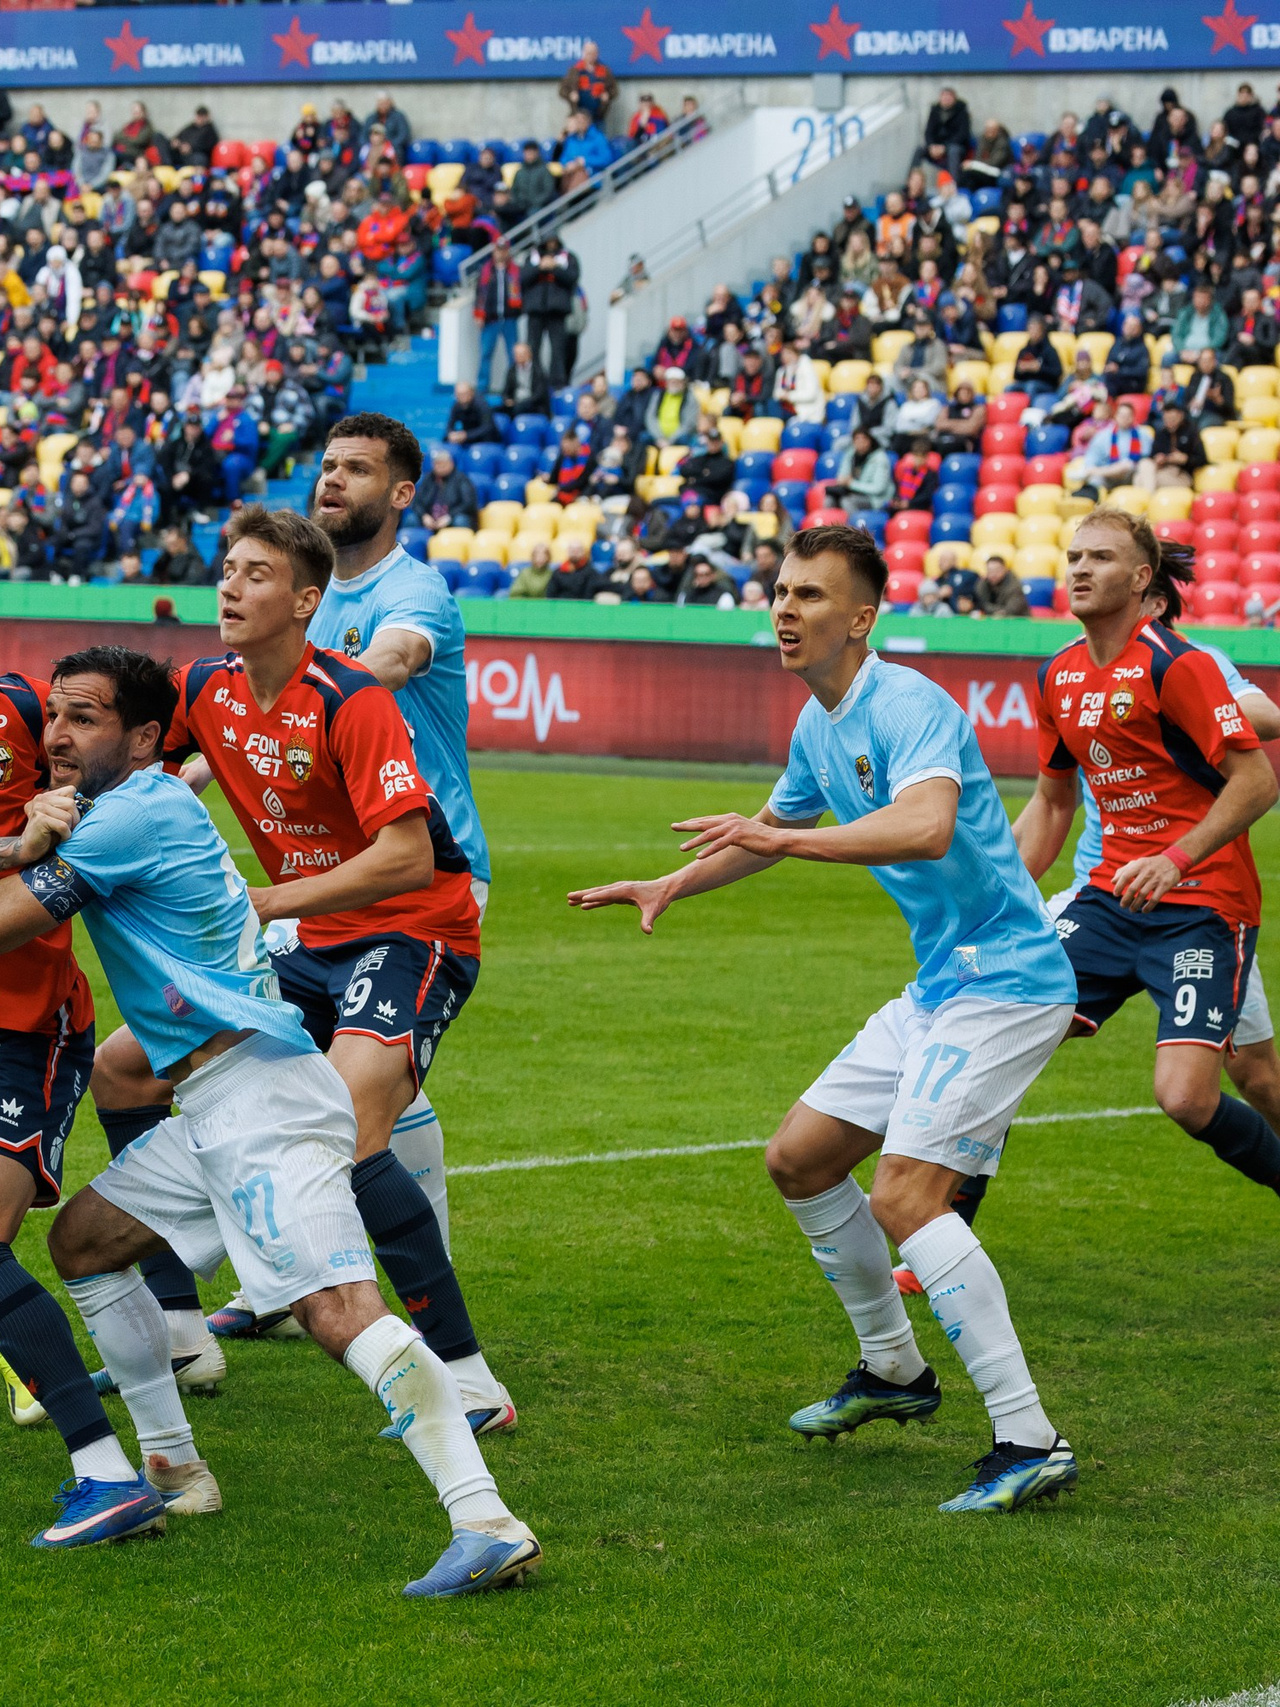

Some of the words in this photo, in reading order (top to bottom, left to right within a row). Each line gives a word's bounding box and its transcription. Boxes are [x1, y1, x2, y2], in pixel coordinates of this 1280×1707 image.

[1080, 692, 1106, 709] FON
[1078, 709, 1103, 727] BET
[1214, 703, 1238, 723] FON
[1221, 717, 1244, 737] BET
[244, 733, 280, 757] FON
[286, 750, 311, 764] ЦСКА
[379, 759, 410, 785] FON
[384, 774, 416, 801] BET
[1101, 791, 1158, 814] билайн
[1173, 983, 1197, 1027] 9
[909, 1042, 972, 1104] 17
[231, 1171, 280, 1250] 27
